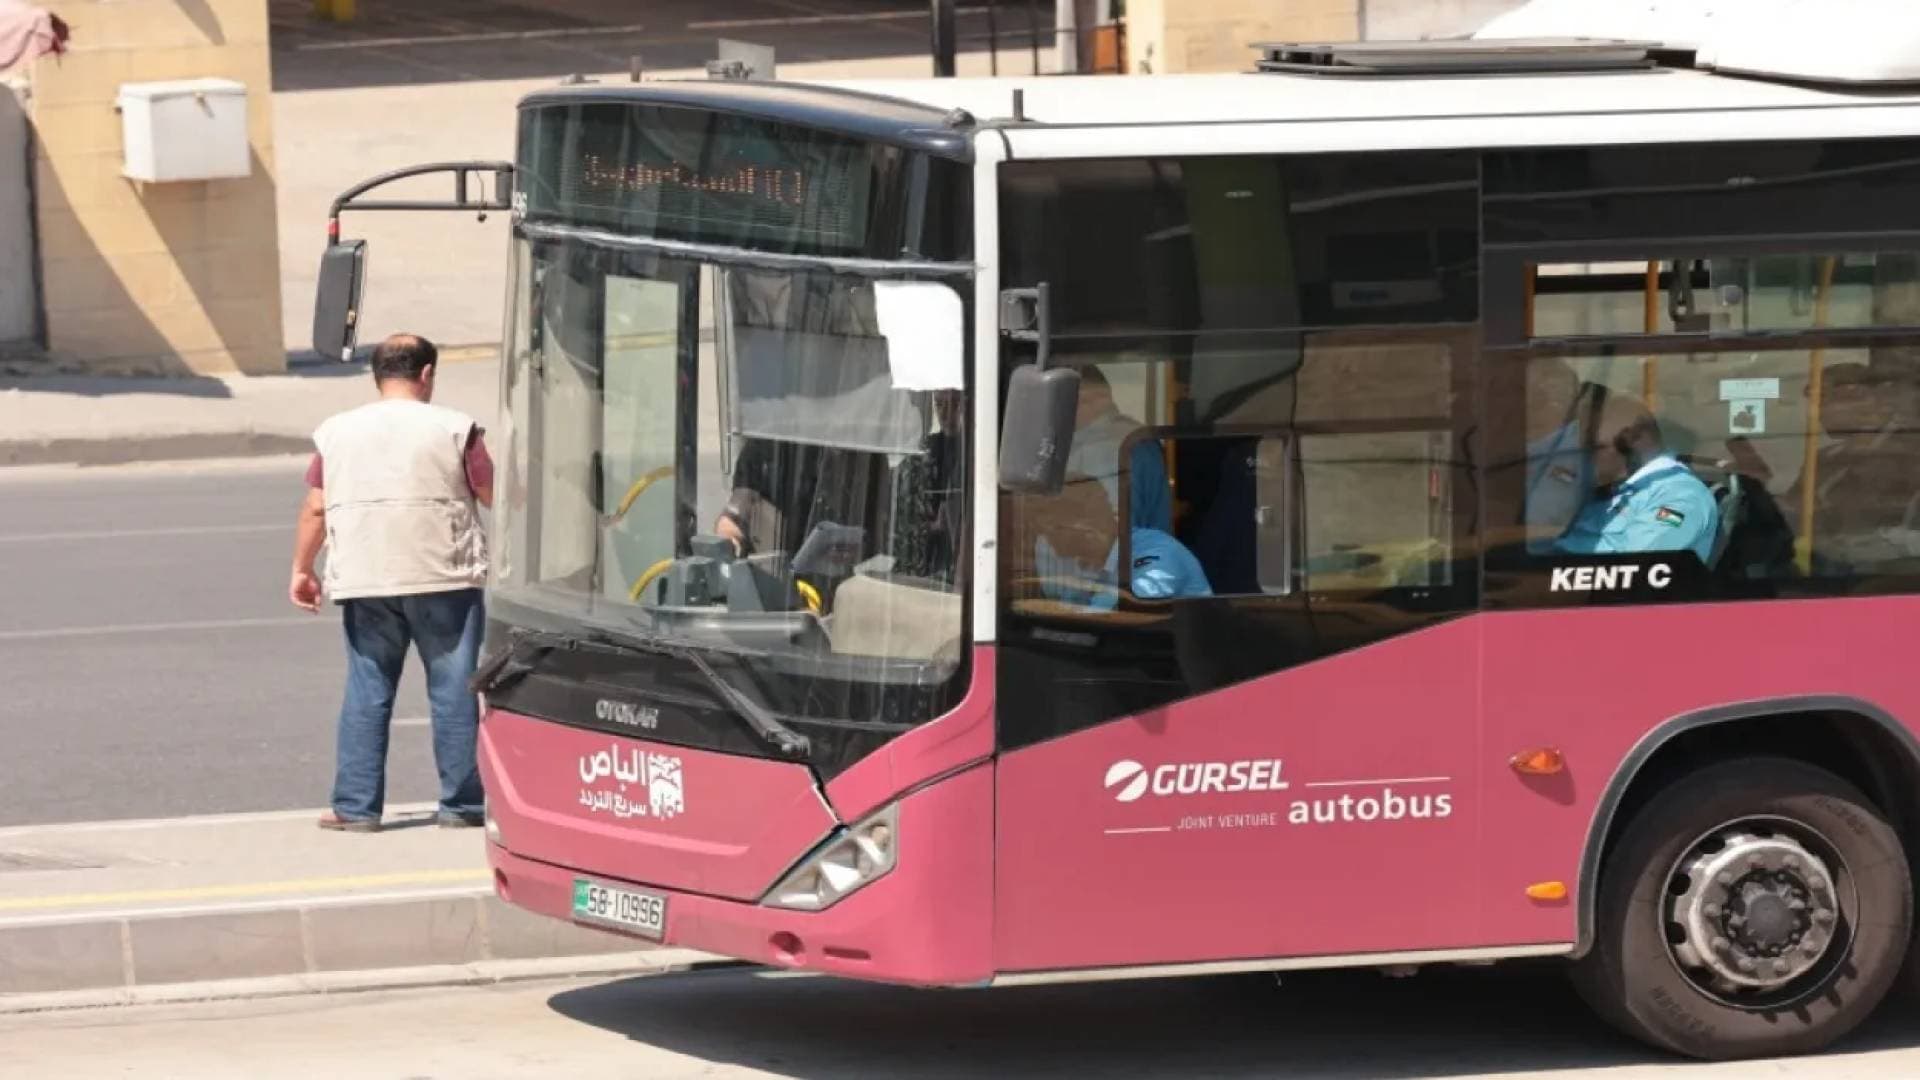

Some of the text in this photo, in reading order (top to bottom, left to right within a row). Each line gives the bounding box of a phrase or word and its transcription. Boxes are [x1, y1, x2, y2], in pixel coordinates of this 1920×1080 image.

[1550, 563, 1672, 592] KENT C
[595, 699, 659, 729] OTOKAR
[580, 744, 646, 791] الباص
[1152, 759, 1289, 795] GÜRSEL
[579, 788, 647, 817] سريع التردد
[1289, 788, 1453, 825] autobus
[1178, 812, 1278, 829] JOINT VENTURE
